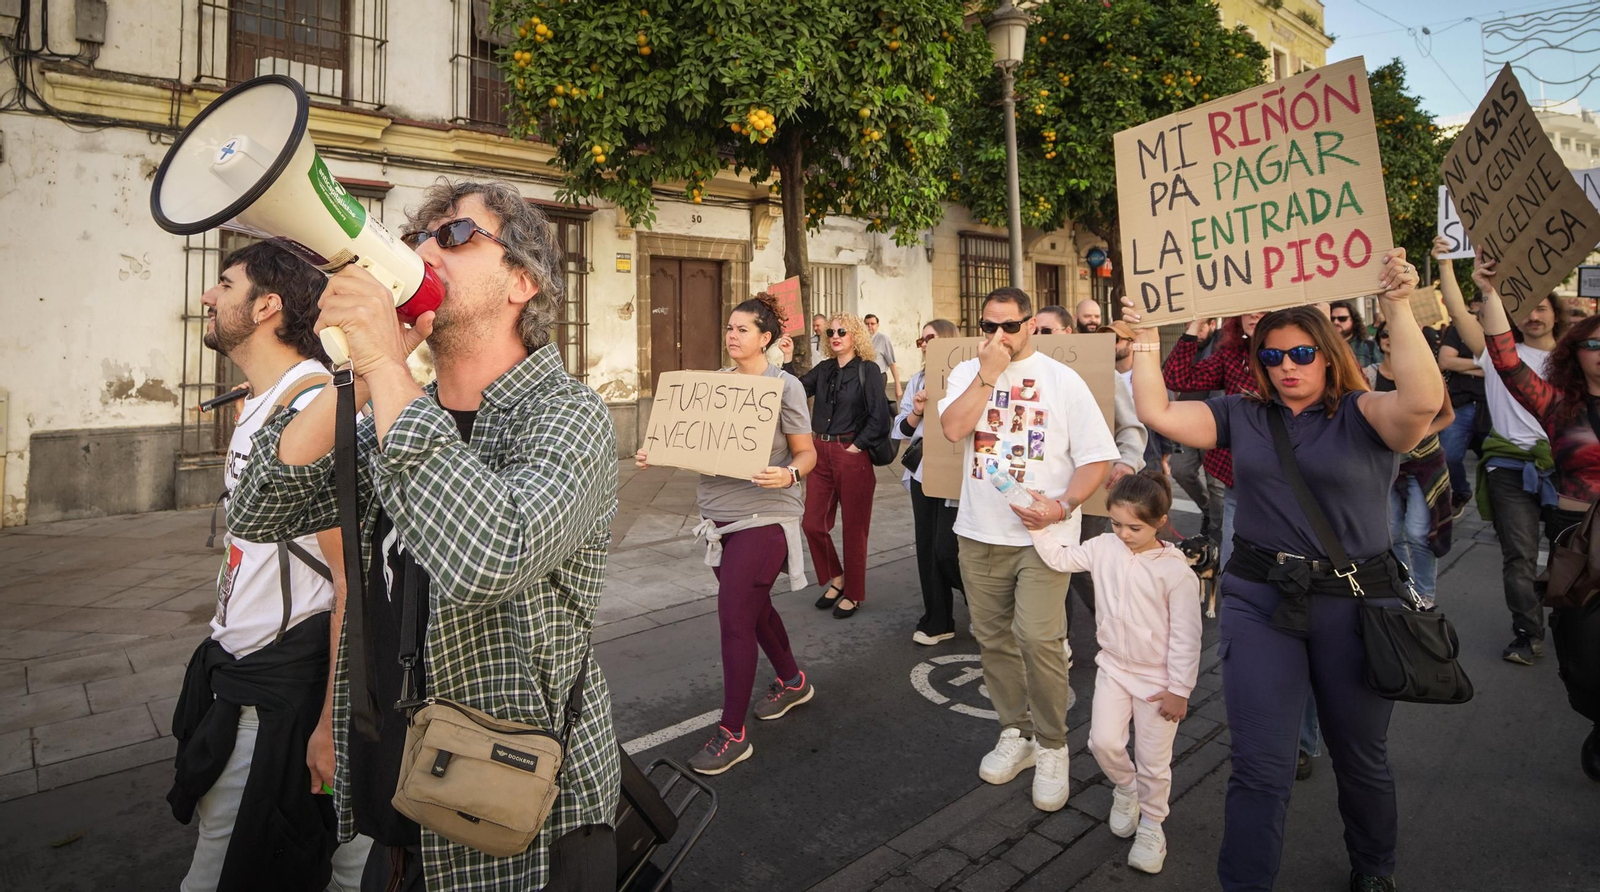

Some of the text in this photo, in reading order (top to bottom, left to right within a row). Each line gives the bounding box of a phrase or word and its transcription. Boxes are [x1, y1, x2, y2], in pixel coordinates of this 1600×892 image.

[1137, 73, 1360, 179] MI RIÑÓN
[1213, 131, 1360, 200] PAGAR
[1444, 81, 1518, 198] NI CASAS
[1460, 113, 1537, 231] SIN GENTE
[1133, 181, 1364, 275] LA ENTRADA
[1498, 153, 1561, 244] GENTE
[1140, 228, 1372, 314] DE UN PISO
[1500, 266, 1533, 313] SIN
[1528, 208, 1587, 275] CASA
[508, 753, 535, 765] DOCKERS
